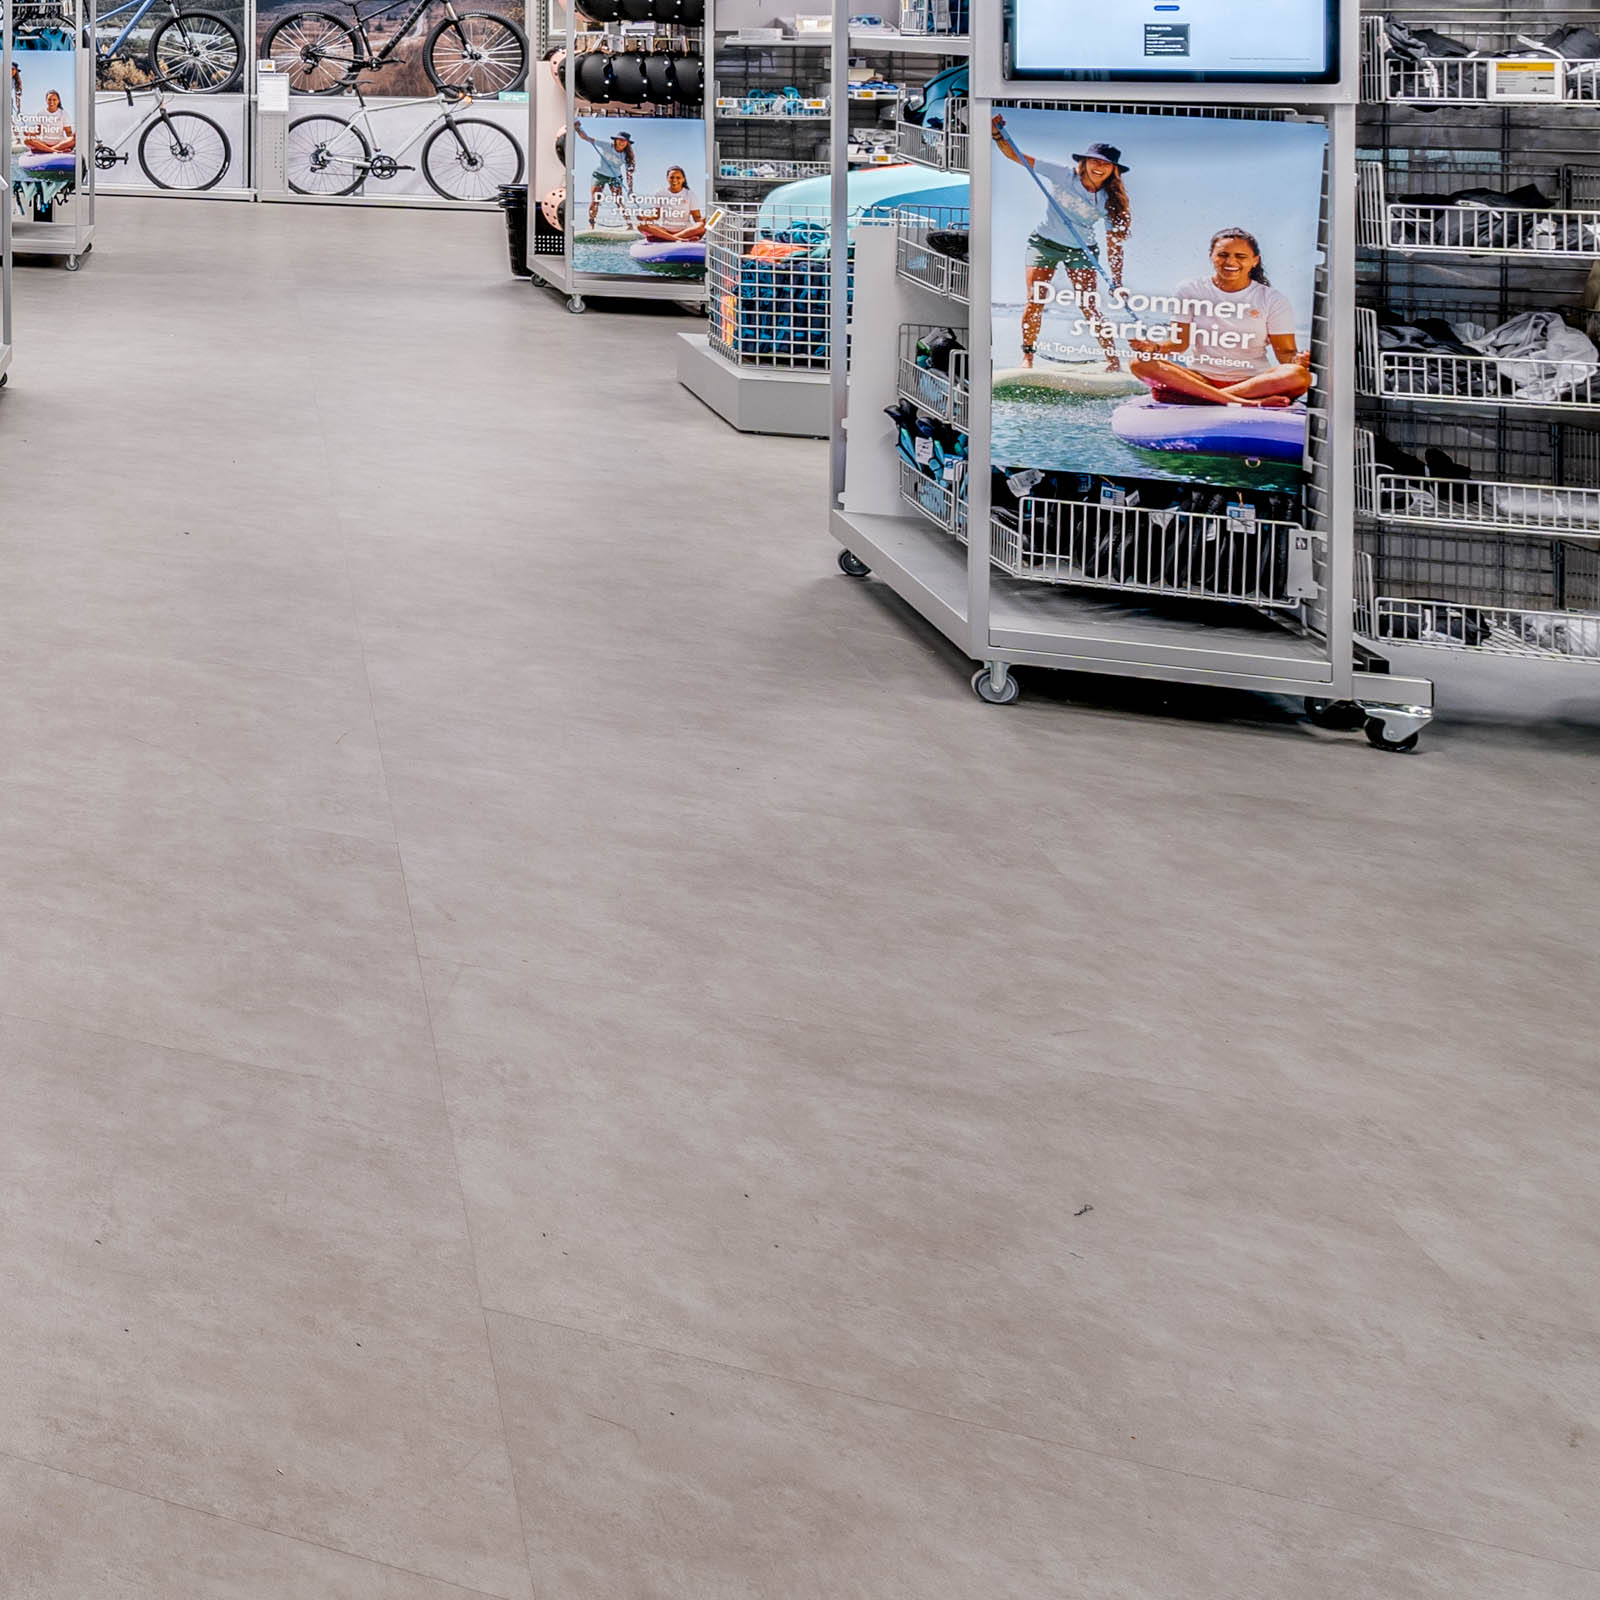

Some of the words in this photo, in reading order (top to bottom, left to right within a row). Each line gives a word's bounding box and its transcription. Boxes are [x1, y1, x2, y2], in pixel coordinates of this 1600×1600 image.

[594, 192, 624, 203] Dein
[627, 193, 683, 206] Sommer
[611, 206, 658, 217] startet
[660, 207, 686, 218] hier
[1032, 280, 1100, 312] Dein
[1108, 286, 1252, 320] Sommer
[1069, 317, 1183, 345] startet
[1189, 322, 1257, 350] hier
[1033, 340, 1052, 352] Mit
[1055, 342, 1151, 362] Top-Ausrüstung
[1152, 352, 1169, 362] zu
[1171, 352, 1256, 369] Top-Preisen.
